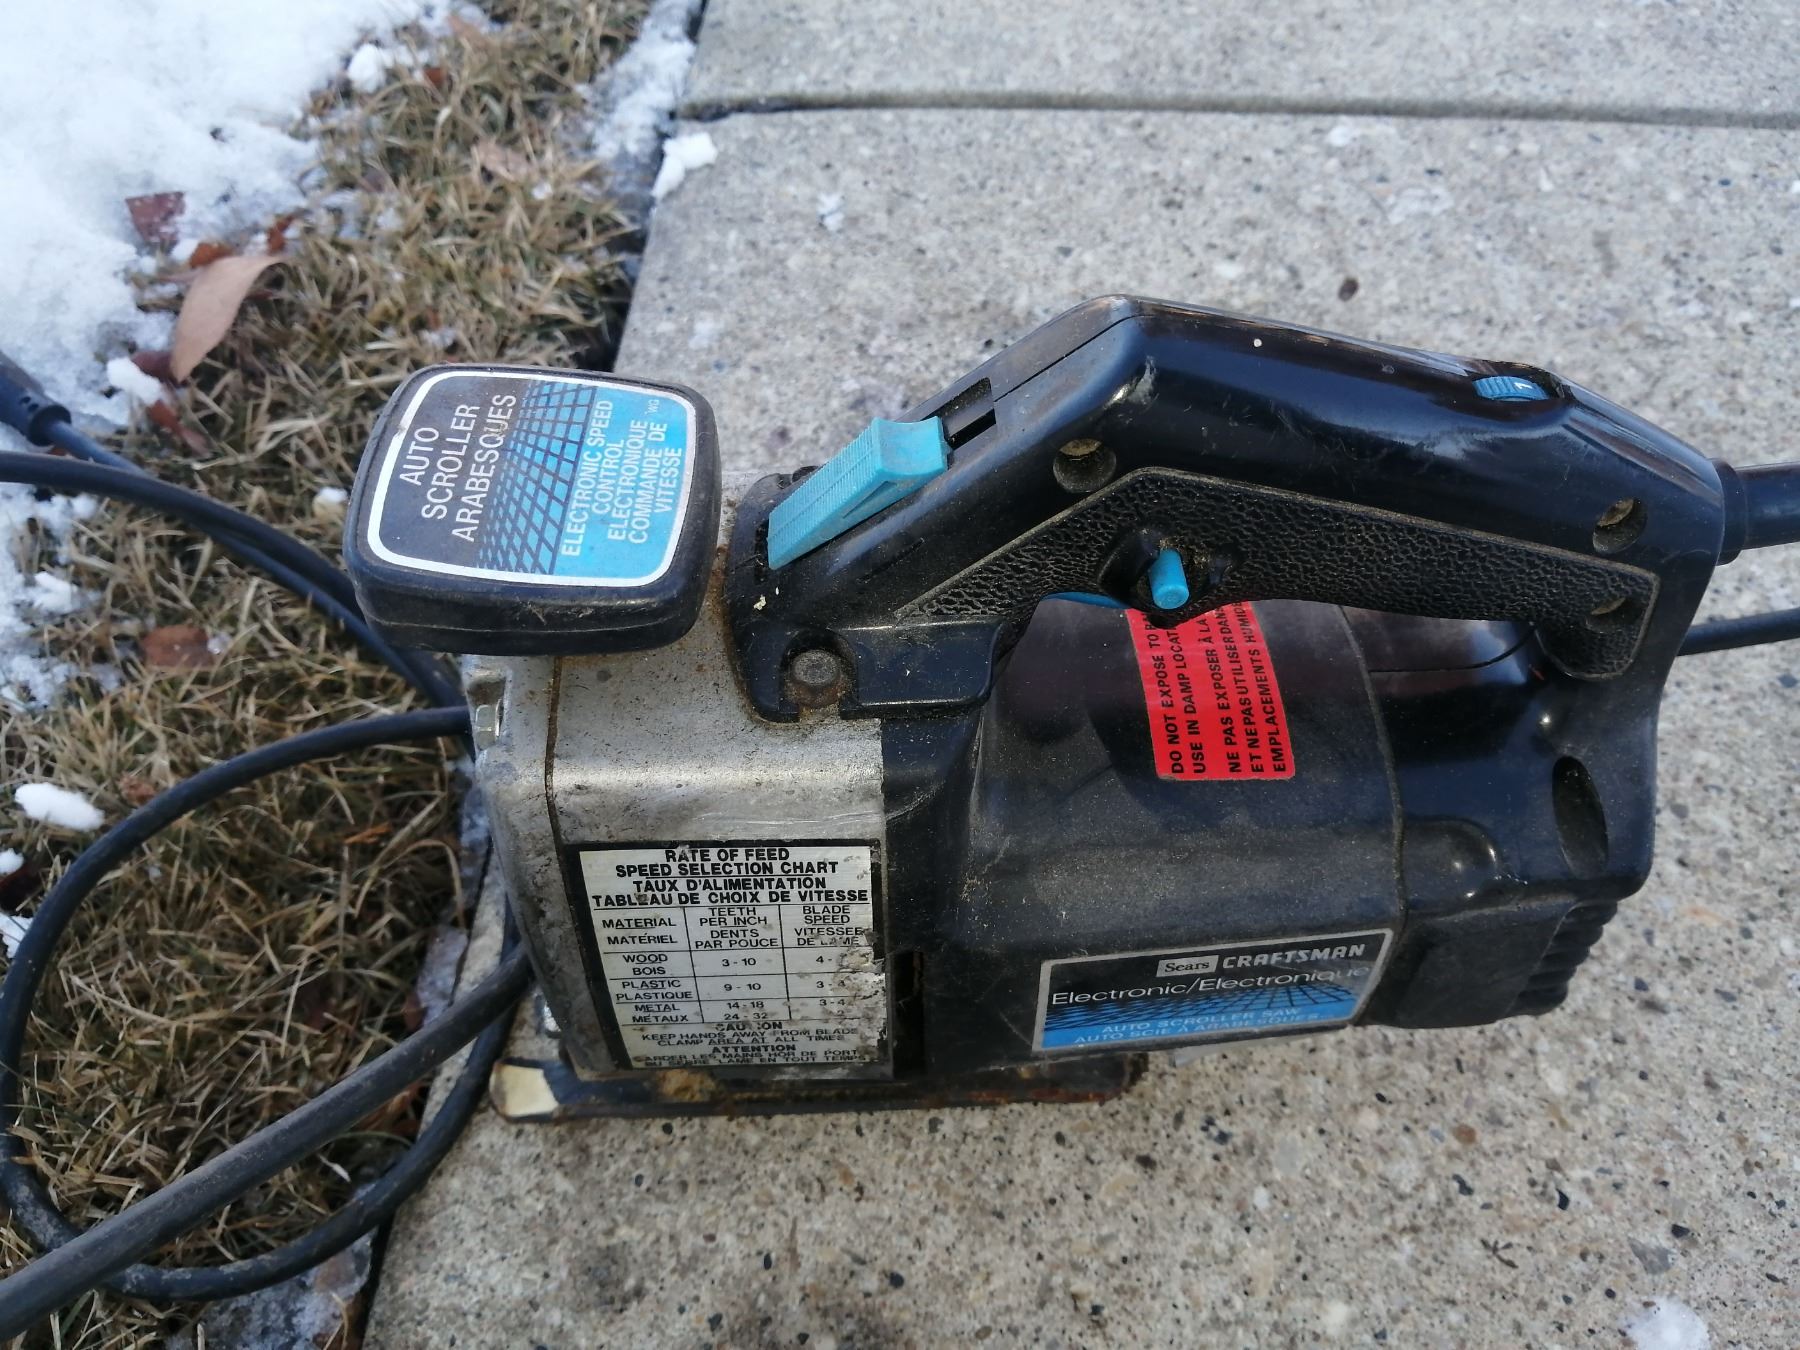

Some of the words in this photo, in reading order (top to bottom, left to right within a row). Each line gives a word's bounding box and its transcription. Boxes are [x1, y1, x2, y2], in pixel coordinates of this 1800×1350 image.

[400, 427, 439, 485] AUTO
[421, 404, 480, 519] SCROLLER
[451, 395, 516, 542] ARABESQUES
[592, 439, 624, 515] CONTROL
[561, 451, 602, 556] ELECTRONIC
[586, 400, 613, 447] SPEED
[608, 420, 648, 541] ELECTRONIQUE
[628, 448, 663, 544] COMMANDE
[648, 422, 667, 442] DE
[654, 448, 682, 513] VITESSE
[1197, 618, 1211, 633] LA
[1147, 634, 1161, 648] TO
[1223, 636, 1249, 696] UTILISER
[1152, 655, 1174, 708] EXPOSE
[1205, 649, 1231, 710] EXPOSER
[1178, 673, 1196, 714] DAMP
[1239, 697, 1257, 727] PAS
[1248, 649, 1286, 772] EMPLACEMENTS
[1164, 714, 1180, 744] NOT
[1187, 719, 1200, 735] IN
[1220, 716, 1237, 745] PAS
[1245, 728, 1260, 749] NE
[1170, 750, 1184, 773] DO
[1189, 742, 1206, 773] USE
[1227, 752, 1242, 773] NE
[1249, 752, 1265, 773] ET
[665, 849, 711, 862] RATE
[717, 849, 739, 861] OF
[745, 848, 790, 861] FEED
[616, 863, 672, 877] SPEED
[678, 862, 774, 876] SELECTION
[781, 862, 838, 874] CHART
[633, 879, 679, 892] TAUX
[687, 877, 826, 892] D'ALIMENTATION
[592, 893, 673, 907] TABLEAU
[678, 892, 700, 905] DE
[708, 891, 760, 903] CHOIX
[769, 891, 791, 902] DE
[798, 890, 868, 902] VITESSE
[709, 907, 756, 916] TEETH
[803, 905, 850, 914] BLADE
[602, 918, 677, 928] MATERIAL
[700, 917, 727, 926] PER
[734, 916, 767, 925] INCH
[804, 915, 850, 924] SPEED
[607, 932, 678, 945] MATÉRIEL
[711, 929, 759, 938] DENTS
[797, 937, 815, 946] DE
[695, 940, 722, 949] PAR
[729, 938, 778, 948] POUCE
[622, 953, 668, 963] WOOD
[722, 959, 730, 967] 3
[742, 958, 756, 966] 10
[1164, 959, 1210, 974] Sears
[1222, 943, 1366, 970] CRAFTSMAN
[632, 966, 666, 975] BOIS
[622, 980, 681, 989] PLASTIC
[747, 983, 761, 991] 10
[1052, 965, 1370, 1005] Electronic/Electronique
[616, 991, 693, 1000] PLASTIQUE
[635, 1003, 680, 1012] METAL
[1102, 1022, 1150, 1033] AUTO
[1158, 1013, 1254, 1027] SCROLLER
[1262, 1007, 1298, 1018] SAW
[1074, 1032, 1123, 1043] AUTO
[712, 1044, 796, 1053] ATTENTION
